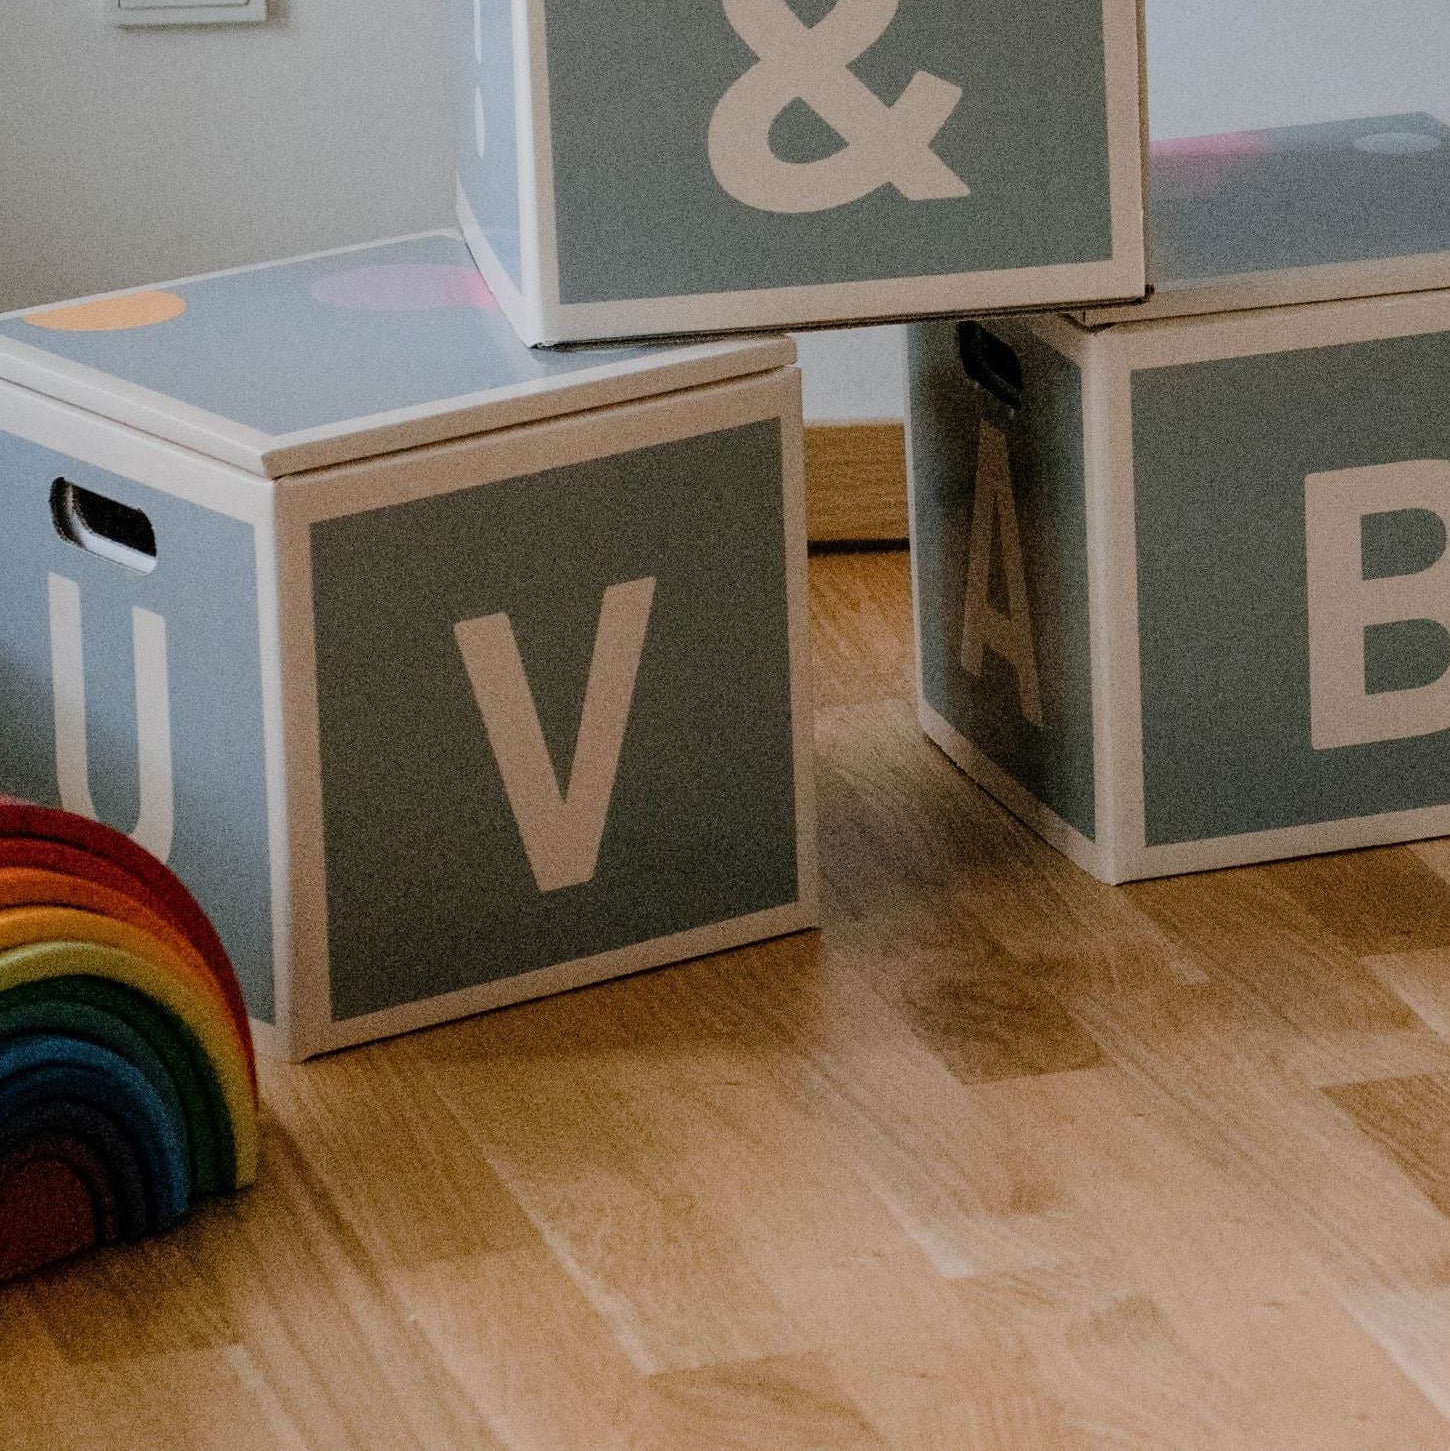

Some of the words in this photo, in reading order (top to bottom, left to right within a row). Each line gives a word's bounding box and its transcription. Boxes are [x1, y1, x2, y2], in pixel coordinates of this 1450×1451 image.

[47, 571, 174, 865] U
[959, 414, 1044, 730] A
[453, 576, 657, 892] V
